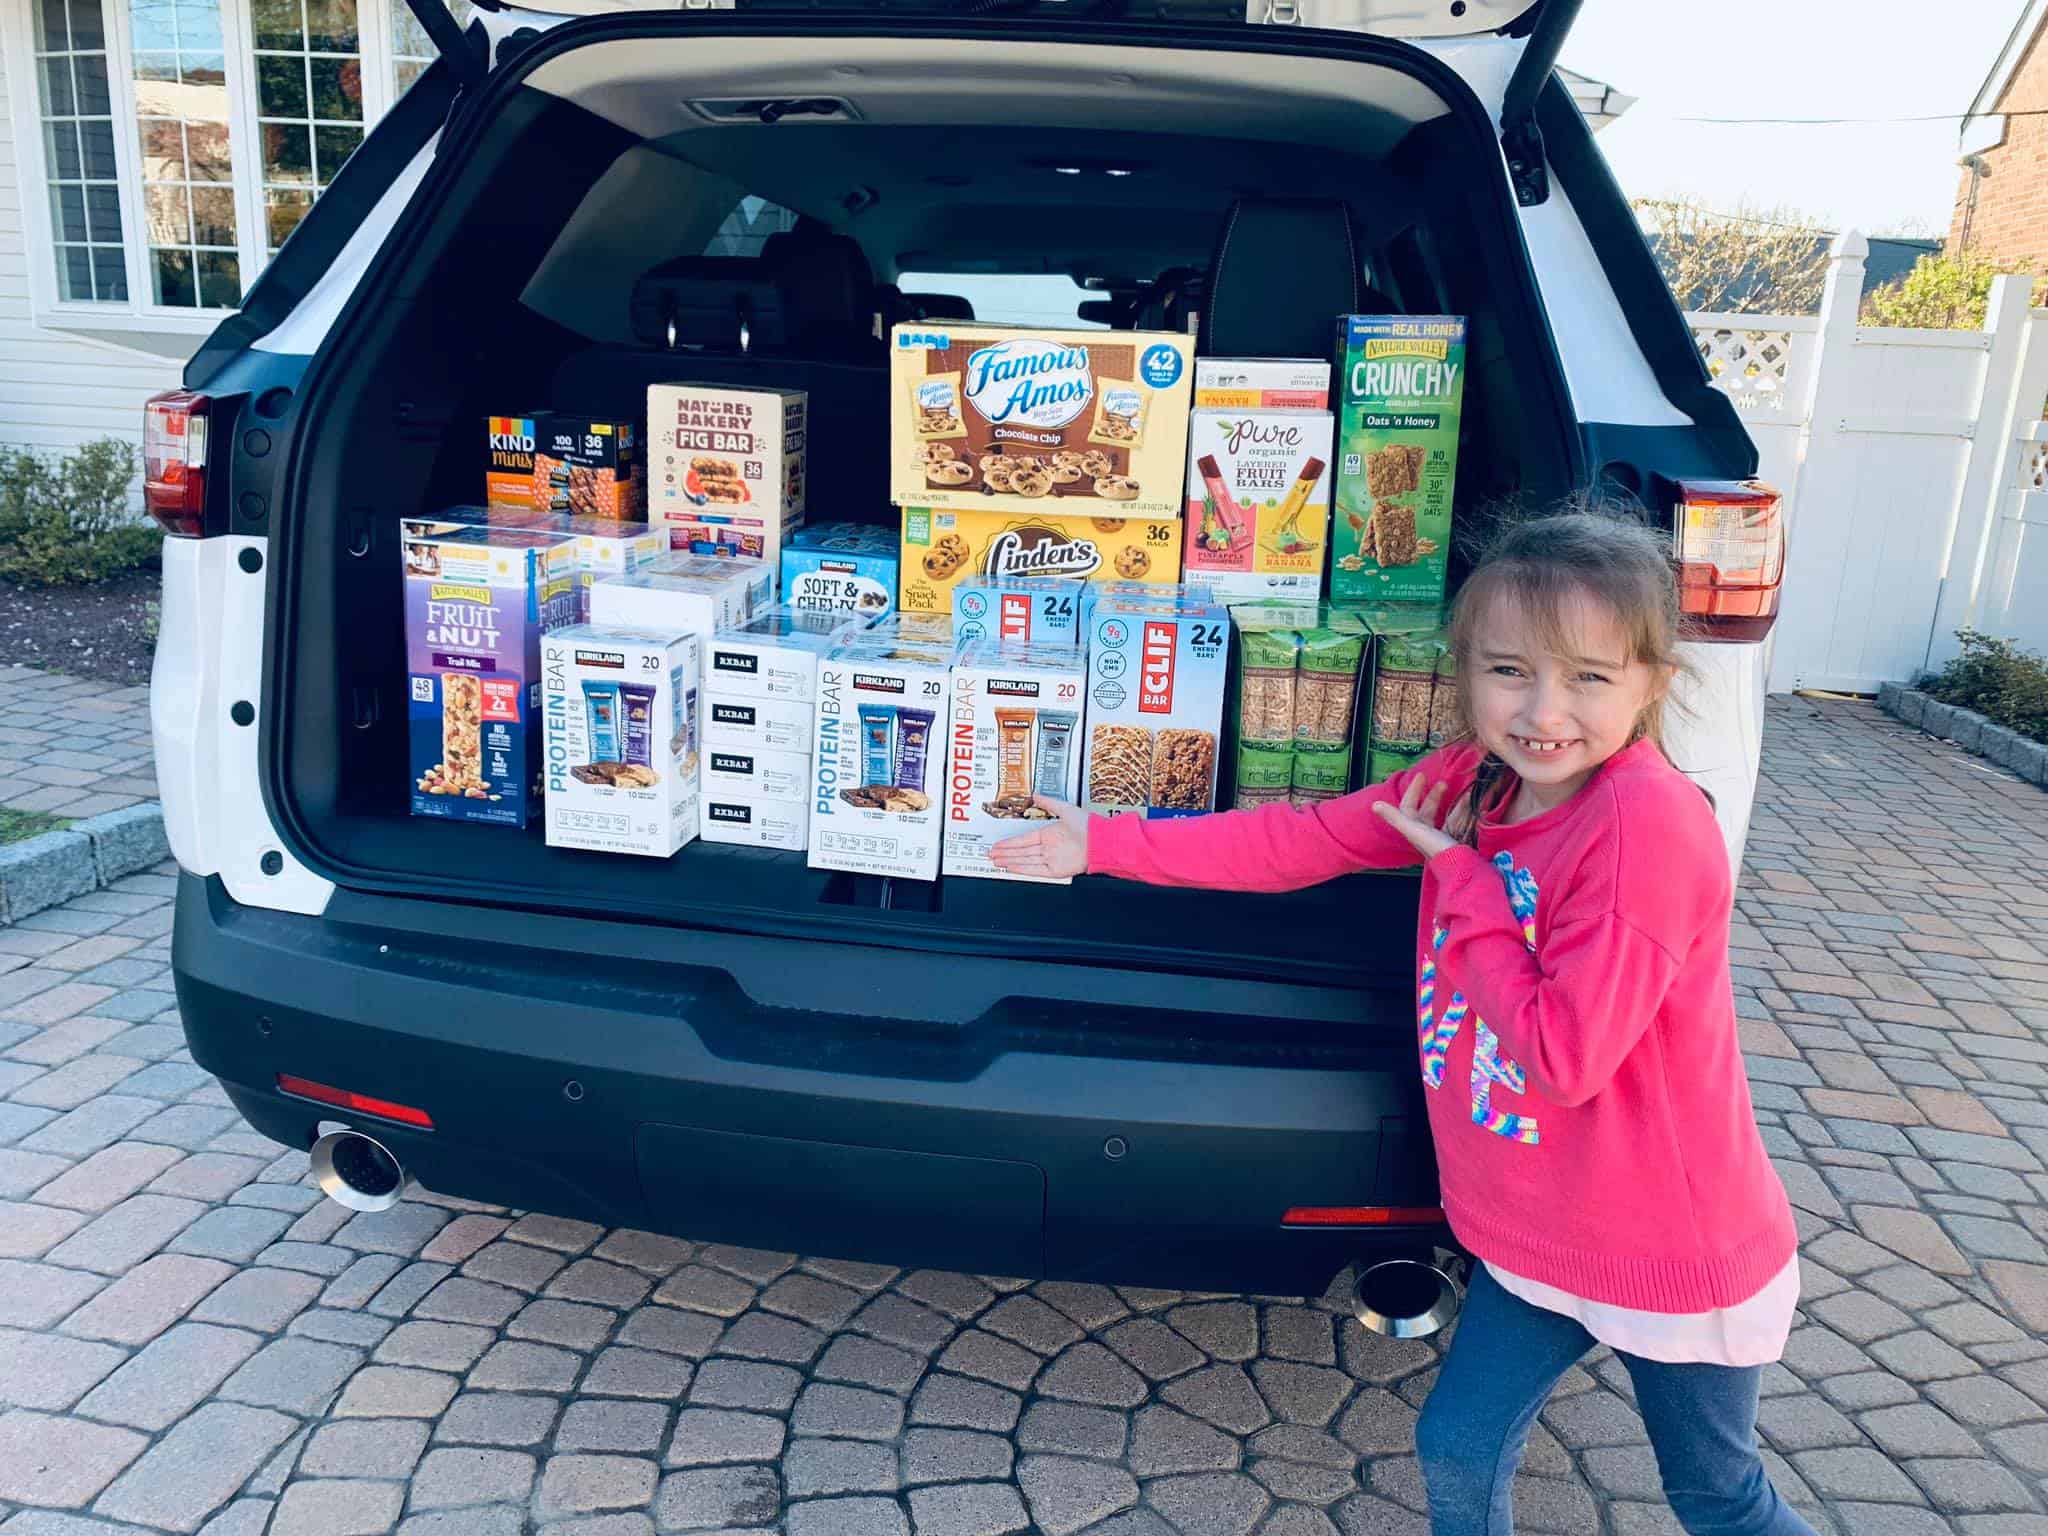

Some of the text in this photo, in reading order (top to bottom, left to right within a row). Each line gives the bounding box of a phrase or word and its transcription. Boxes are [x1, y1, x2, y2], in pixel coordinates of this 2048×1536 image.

[1392, 323, 1420, 336] REAL
[1423, 323, 1464, 336] HONEY
[1369, 341, 1444, 355] NATURE VALLEY
[1147, 351, 1176, 371] 42
[966, 346, 1087, 397] Famous
[1351, 361, 1458, 396] CRUNCHY
[991, 378, 1092, 421] Amos
[677, 413, 752, 430] BAKERY
[1367, 415, 1390, 426] Oats
[1404, 415, 1436, 428] Honey
[489, 433, 536, 452] KIND
[554, 435, 572, 446] 100
[584, 434, 603, 449] 36
[679, 431, 750, 451] FIG BAR
[994, 428, 1061, 445] Chocolate Chip
[1228, 419, 1303, 455] pure
[1248, 446, 1297, 458] organic
[1432, 450, 1445, 461] NO
[492, 451, 533, 469] minis
[1236, 461, 1287, 469] LAYERED
[1347, 455, 1358, 465] 49
[746, 462, 762, 476] 36
[1236, 468, 1287, 480] FRUIT
[1236, 479, 1285, 488] BARS
[1147, 524, 1170, 541] 36
[989, 535, 1098, 577] Linden's
[1265, 559, 1312, 568] BANANA
[804, 578, 859, 598] SOFT &
[905, 588, 937, 600] Snack
[908, 598, 934, 609] Pack
[967, 598, 980, 611] 9g
[1044, 596, 1073, 616] 24
[426, 601, 499, 629] FRUIT
[439, 626, 500, 648] NUT
[1107, 625, 1120, 638] 9g
[1191, 624, 1223, 646] 24
[448, 656, 480, 668] Trail Mix
[577, 651, 624, 663] KIRKLAND
[642, 655, 660, 670] 20
[1144, 627, 1172, 693] CLIF
[546, 647, 566, 692] BAR
[415, 679, 431, 692] 48
[855, 674, 904, 688] KIRKLAND
[922, 681, 941, 696] 20
[989, 680, 1038, 693] KIRKLAND
[1056, 683, 1077, 698] 20
[1143, 694, 1168, 706] BAR
[717, 709, 751, 720] RXBAR
[547, 694, 567, 792] PROTEIN
[817, 670, 842, 816] PROTEIN BAR
[951, 677, 977, 822] PROTEIN BAR
[1247, 768, 1290, 783] rollers
[1302, 770, 1348, 786] rollers
